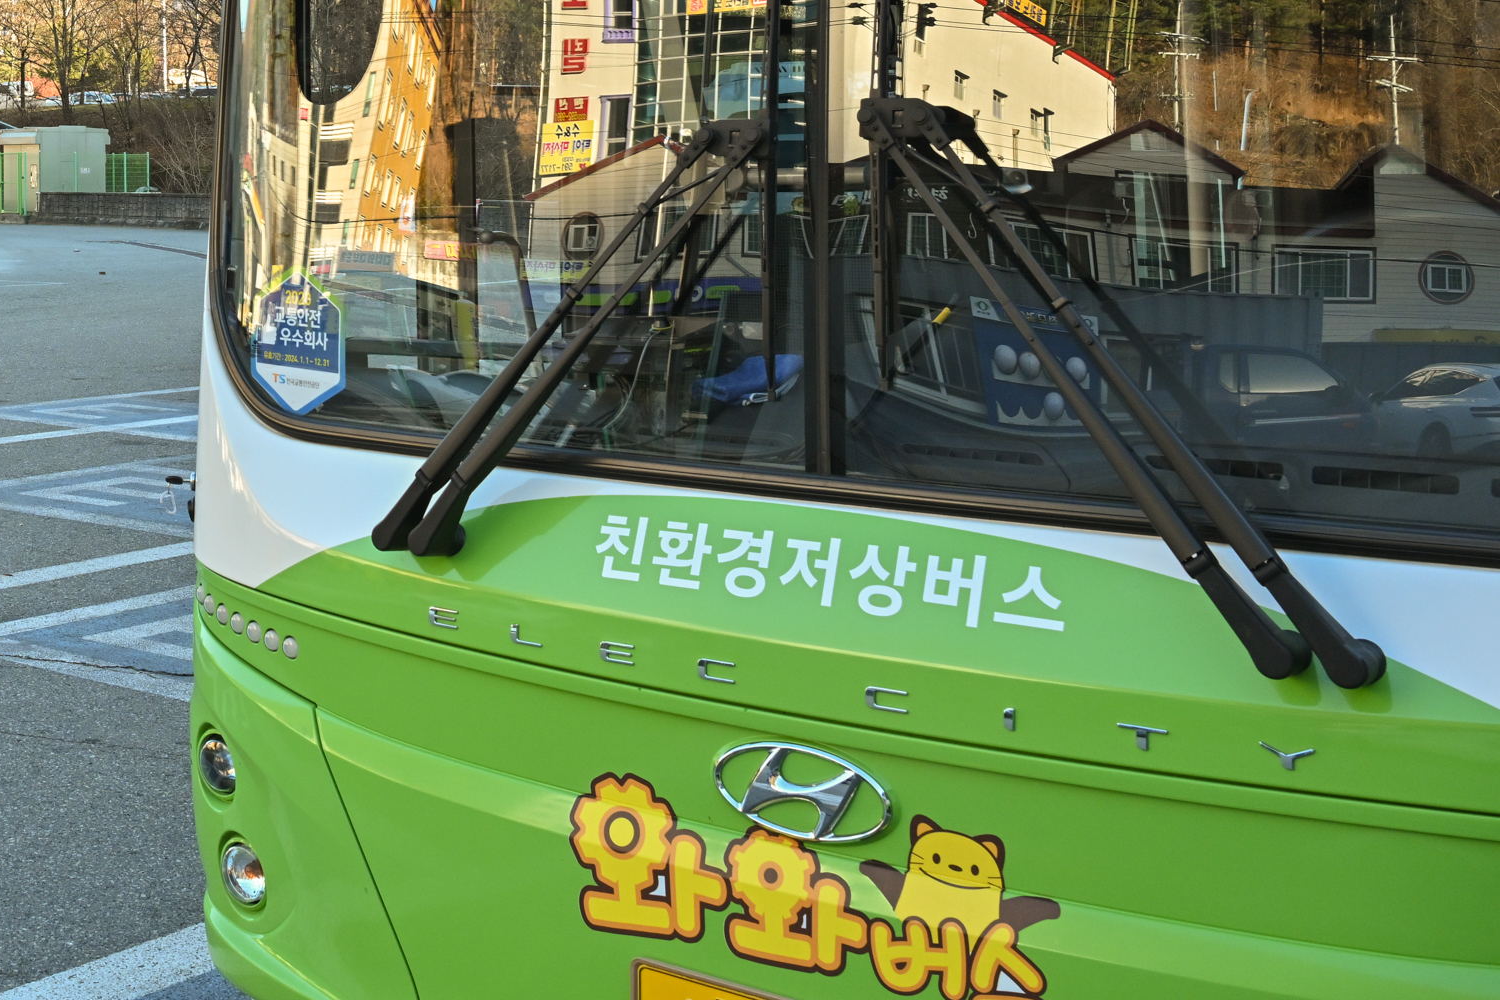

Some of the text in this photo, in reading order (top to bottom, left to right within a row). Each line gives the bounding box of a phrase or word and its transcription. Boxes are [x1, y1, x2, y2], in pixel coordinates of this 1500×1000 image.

[274, 306, 321, 329] 교통안전
[279, 328, 329, 351] 우수회사
[272, 373, 286, 385] TS
[593, 512, 1067, 635] 친환경저상버스
